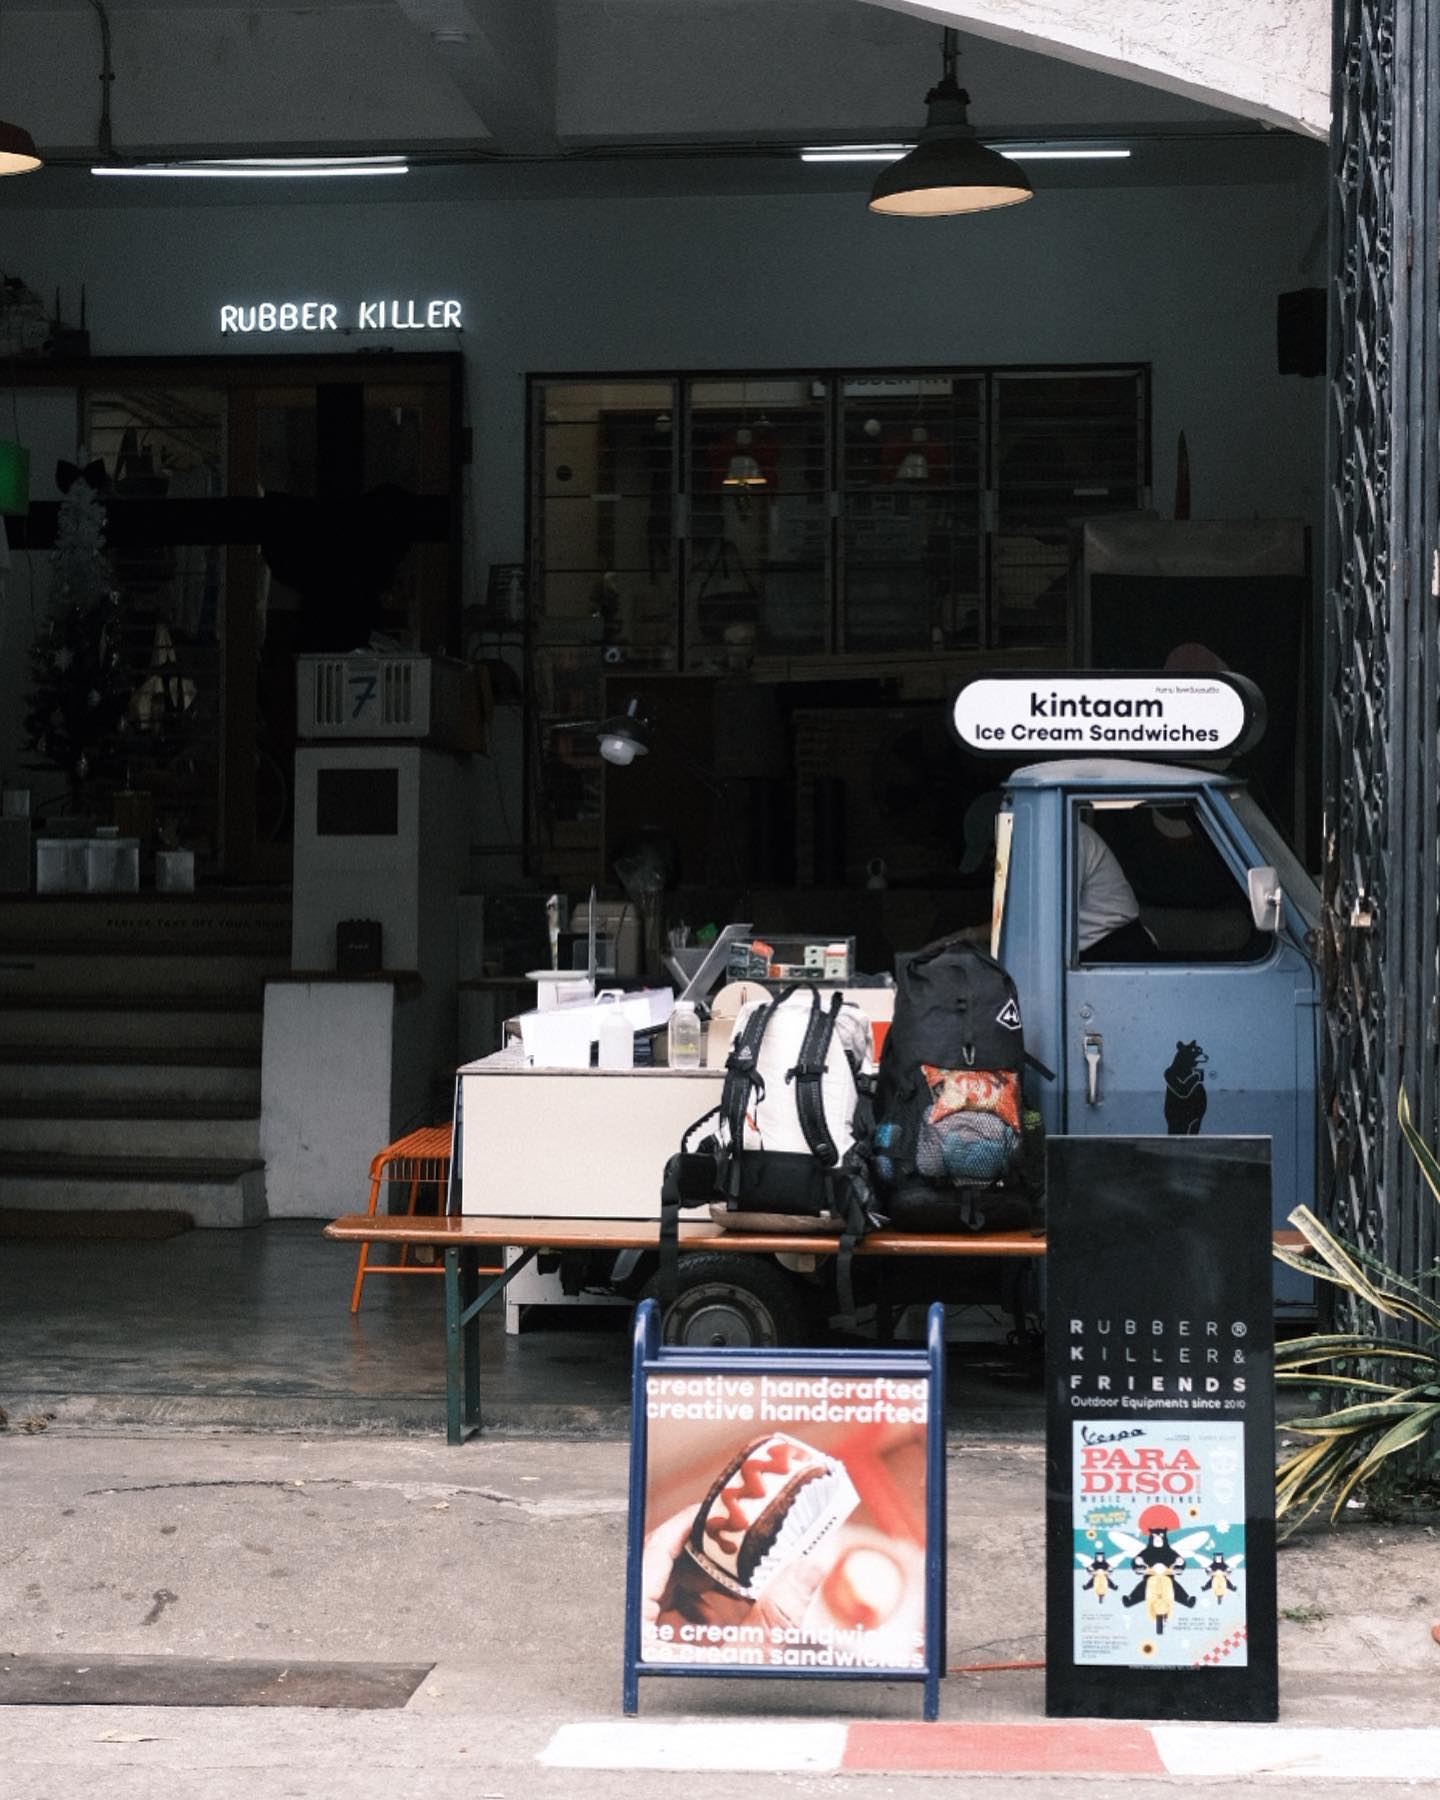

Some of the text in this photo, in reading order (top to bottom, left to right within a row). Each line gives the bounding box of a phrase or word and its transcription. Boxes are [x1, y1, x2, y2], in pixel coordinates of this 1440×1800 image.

[220, 300, 462, 332] RUBBER KILLER
[348, 676, 377, 718] 7
[1030, 692, 1163, 718] kintaam
[975, 723, 1220, 742] Ice Cream Sandwiches
[1070, 1346, 1219, 1363] KILLER
[646, 1375, 929, 1400] creative handcrafted
[1070, 1375, 1246, 1392] FRIENDS
[646, 1398, 929, 1423] creative handcrafted
[1071, 1395, 1246, 1410] Outdoor Equipments since 2010
[1081, 1425, 1147, 1446] Vespa
[1080, 1448, 1200, 1470] PARA
[1081, 1472, 1195, 1494] DISO
[680, 1624, 763, 1643] cream
[771, 1623, 924, 1648] sandwis
